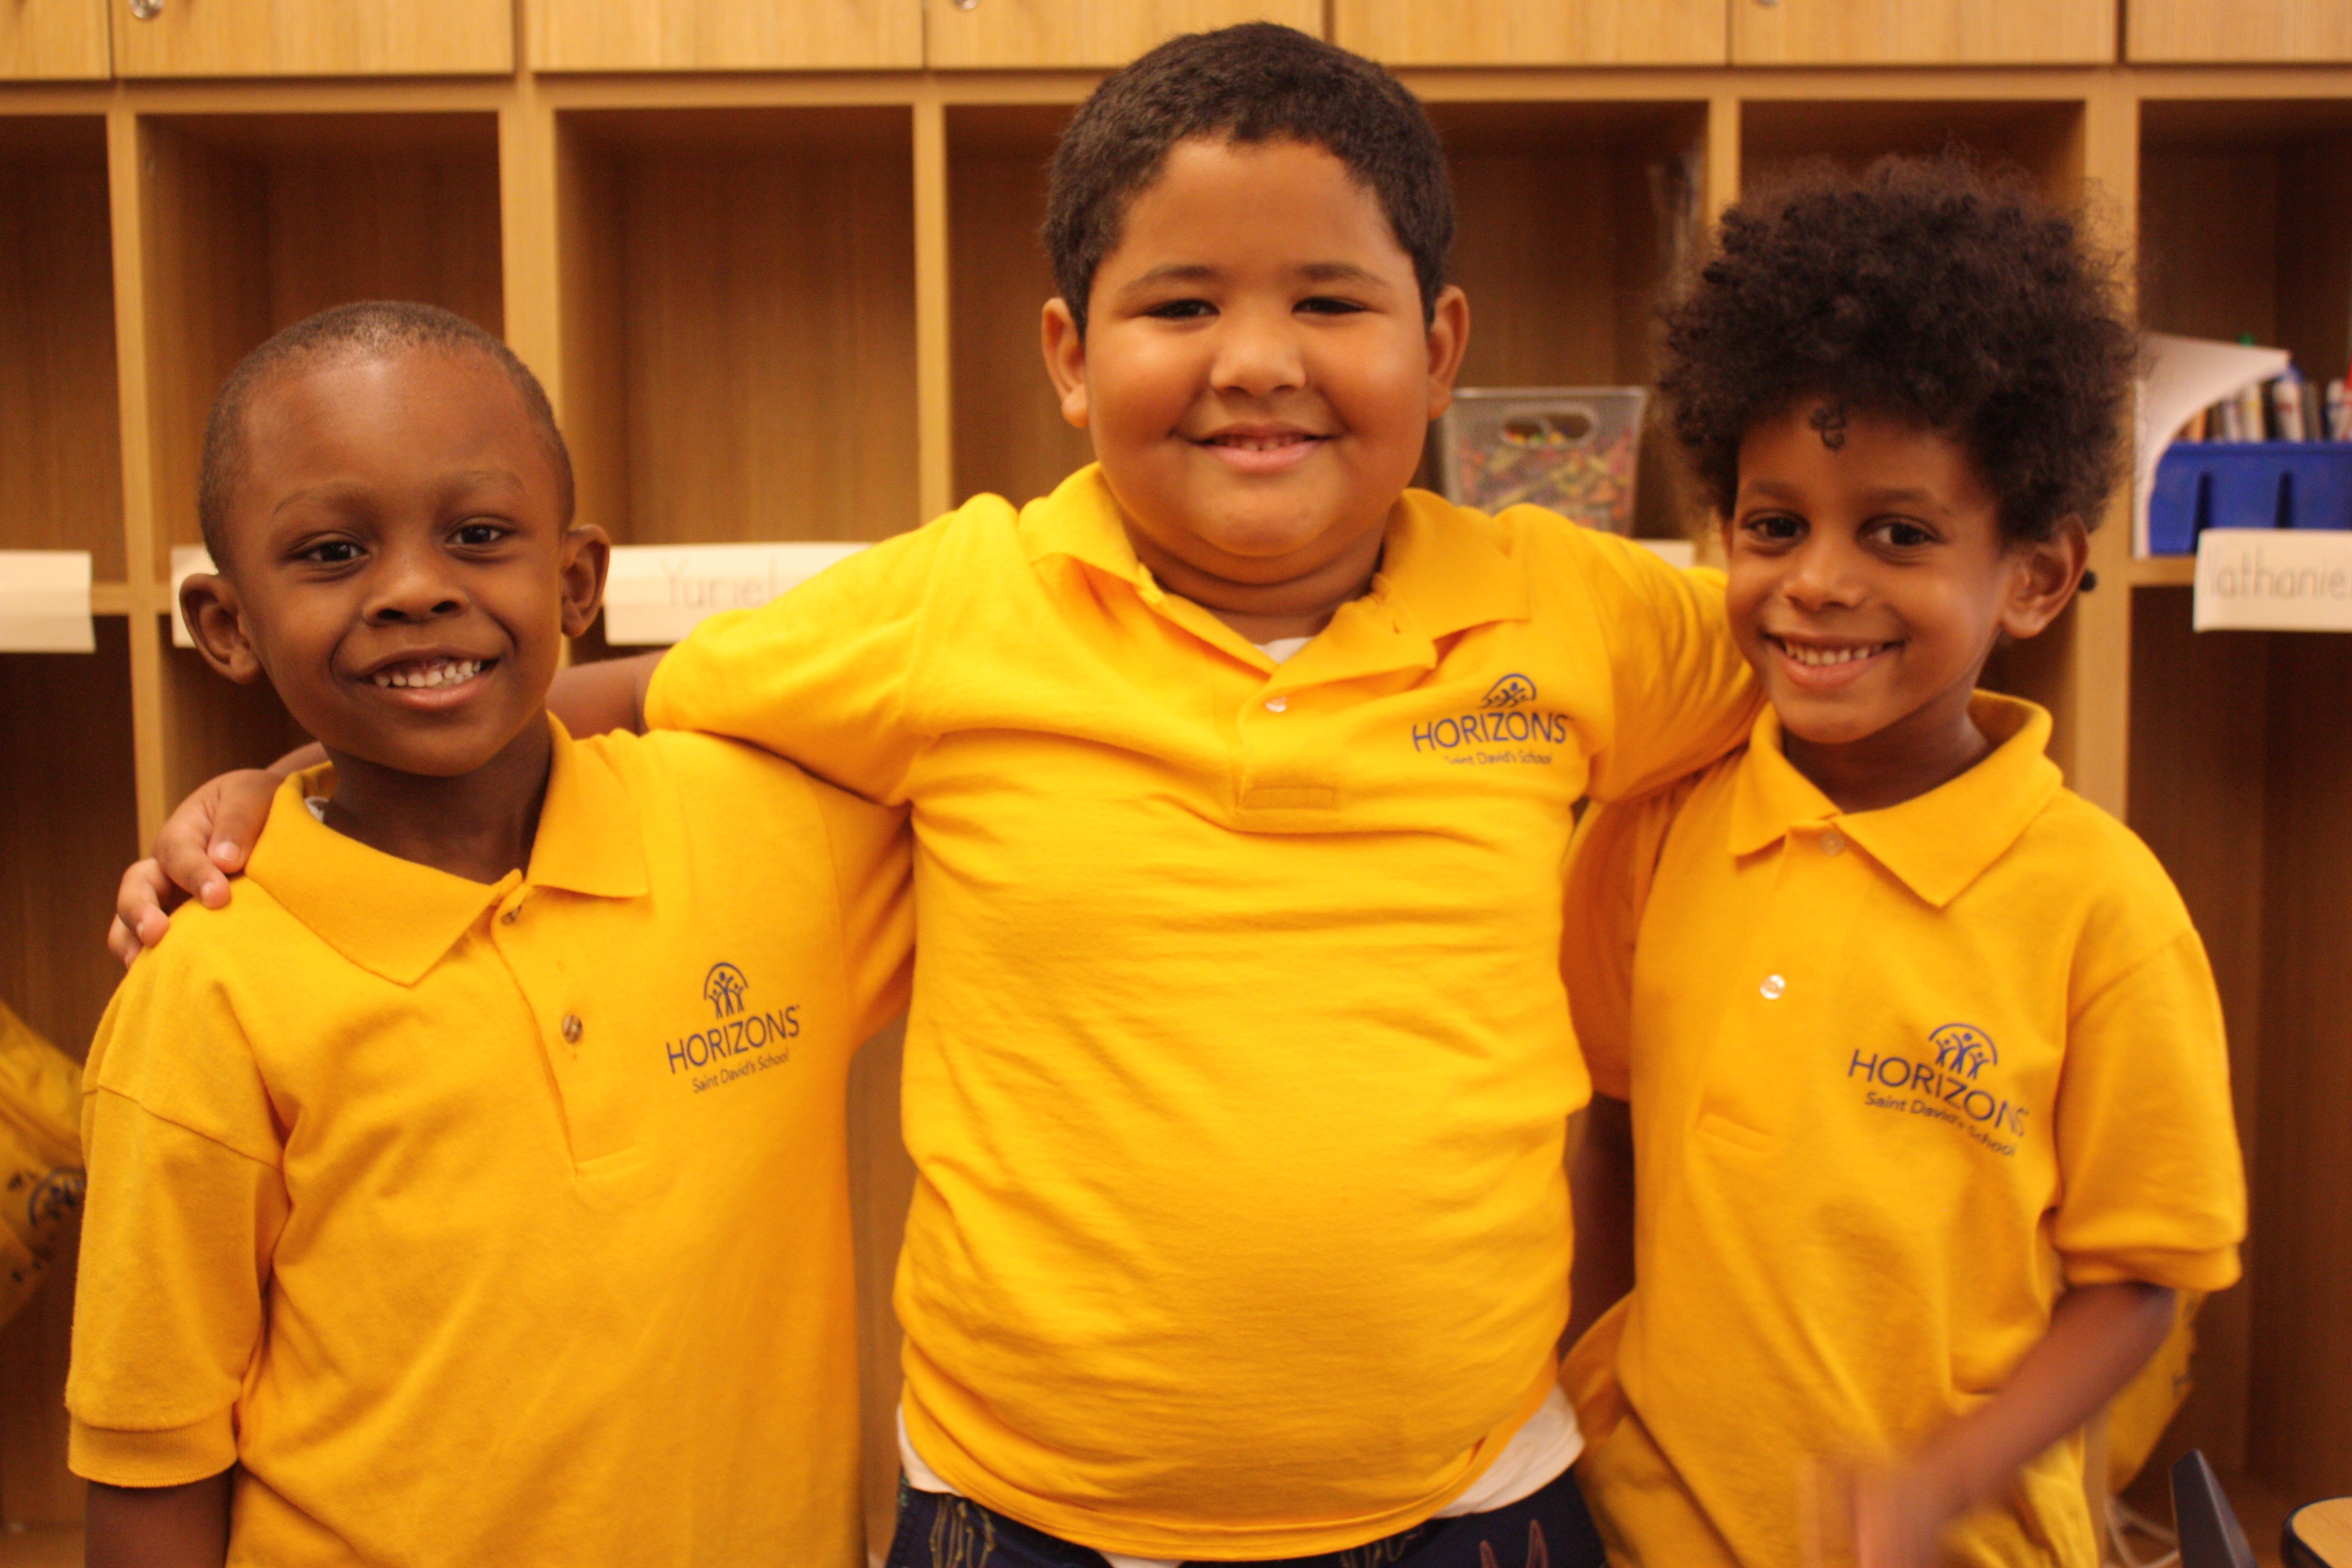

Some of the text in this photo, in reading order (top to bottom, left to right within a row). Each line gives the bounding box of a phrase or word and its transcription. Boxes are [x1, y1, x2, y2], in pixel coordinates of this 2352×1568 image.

[1412, 711, 1569, 752] HORIZONS
[1518, 749, 1551, 765] School
[666, 1005, 799, 1074] HORIZONS
[692, 1047, 790, 1093] Saint David's School
[1864, 1091, 1906, 1112] Saint
[1910, 1099, 1965, 1129] Davids
